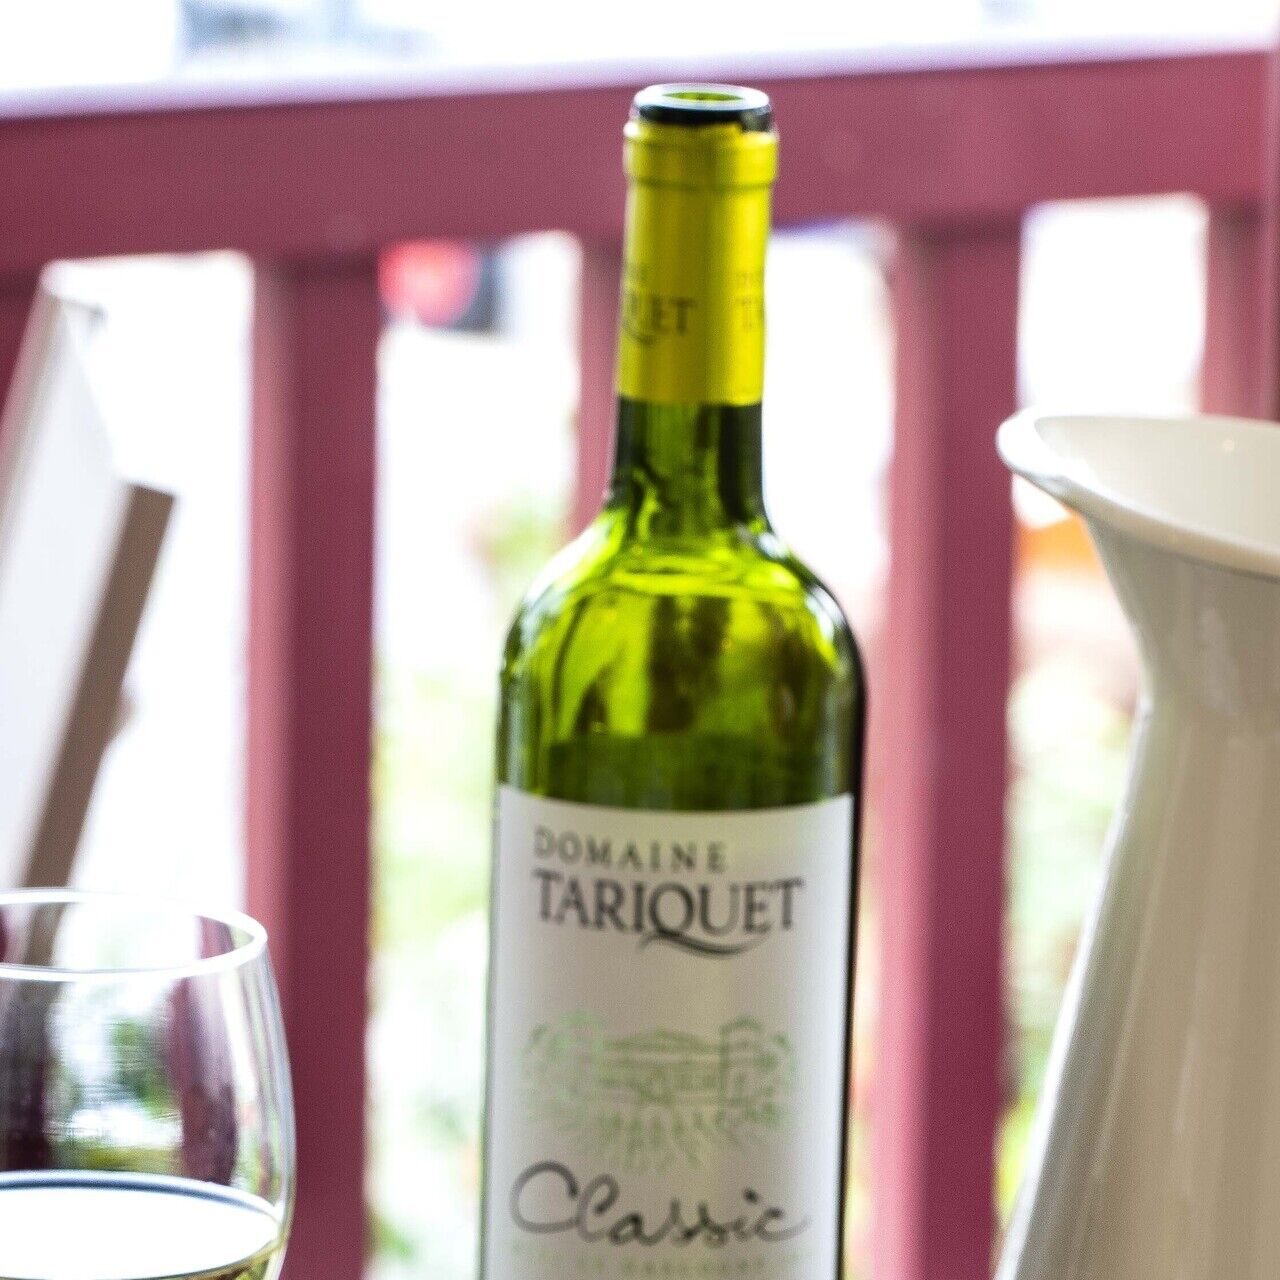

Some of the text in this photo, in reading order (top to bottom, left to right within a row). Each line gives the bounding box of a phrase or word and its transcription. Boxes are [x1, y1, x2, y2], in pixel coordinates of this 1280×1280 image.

[534, 825, 728, 873] DOMAINE
[531, 868, 806, 959] TARIQUET
[510, 1159, 813, 1247] Classic
